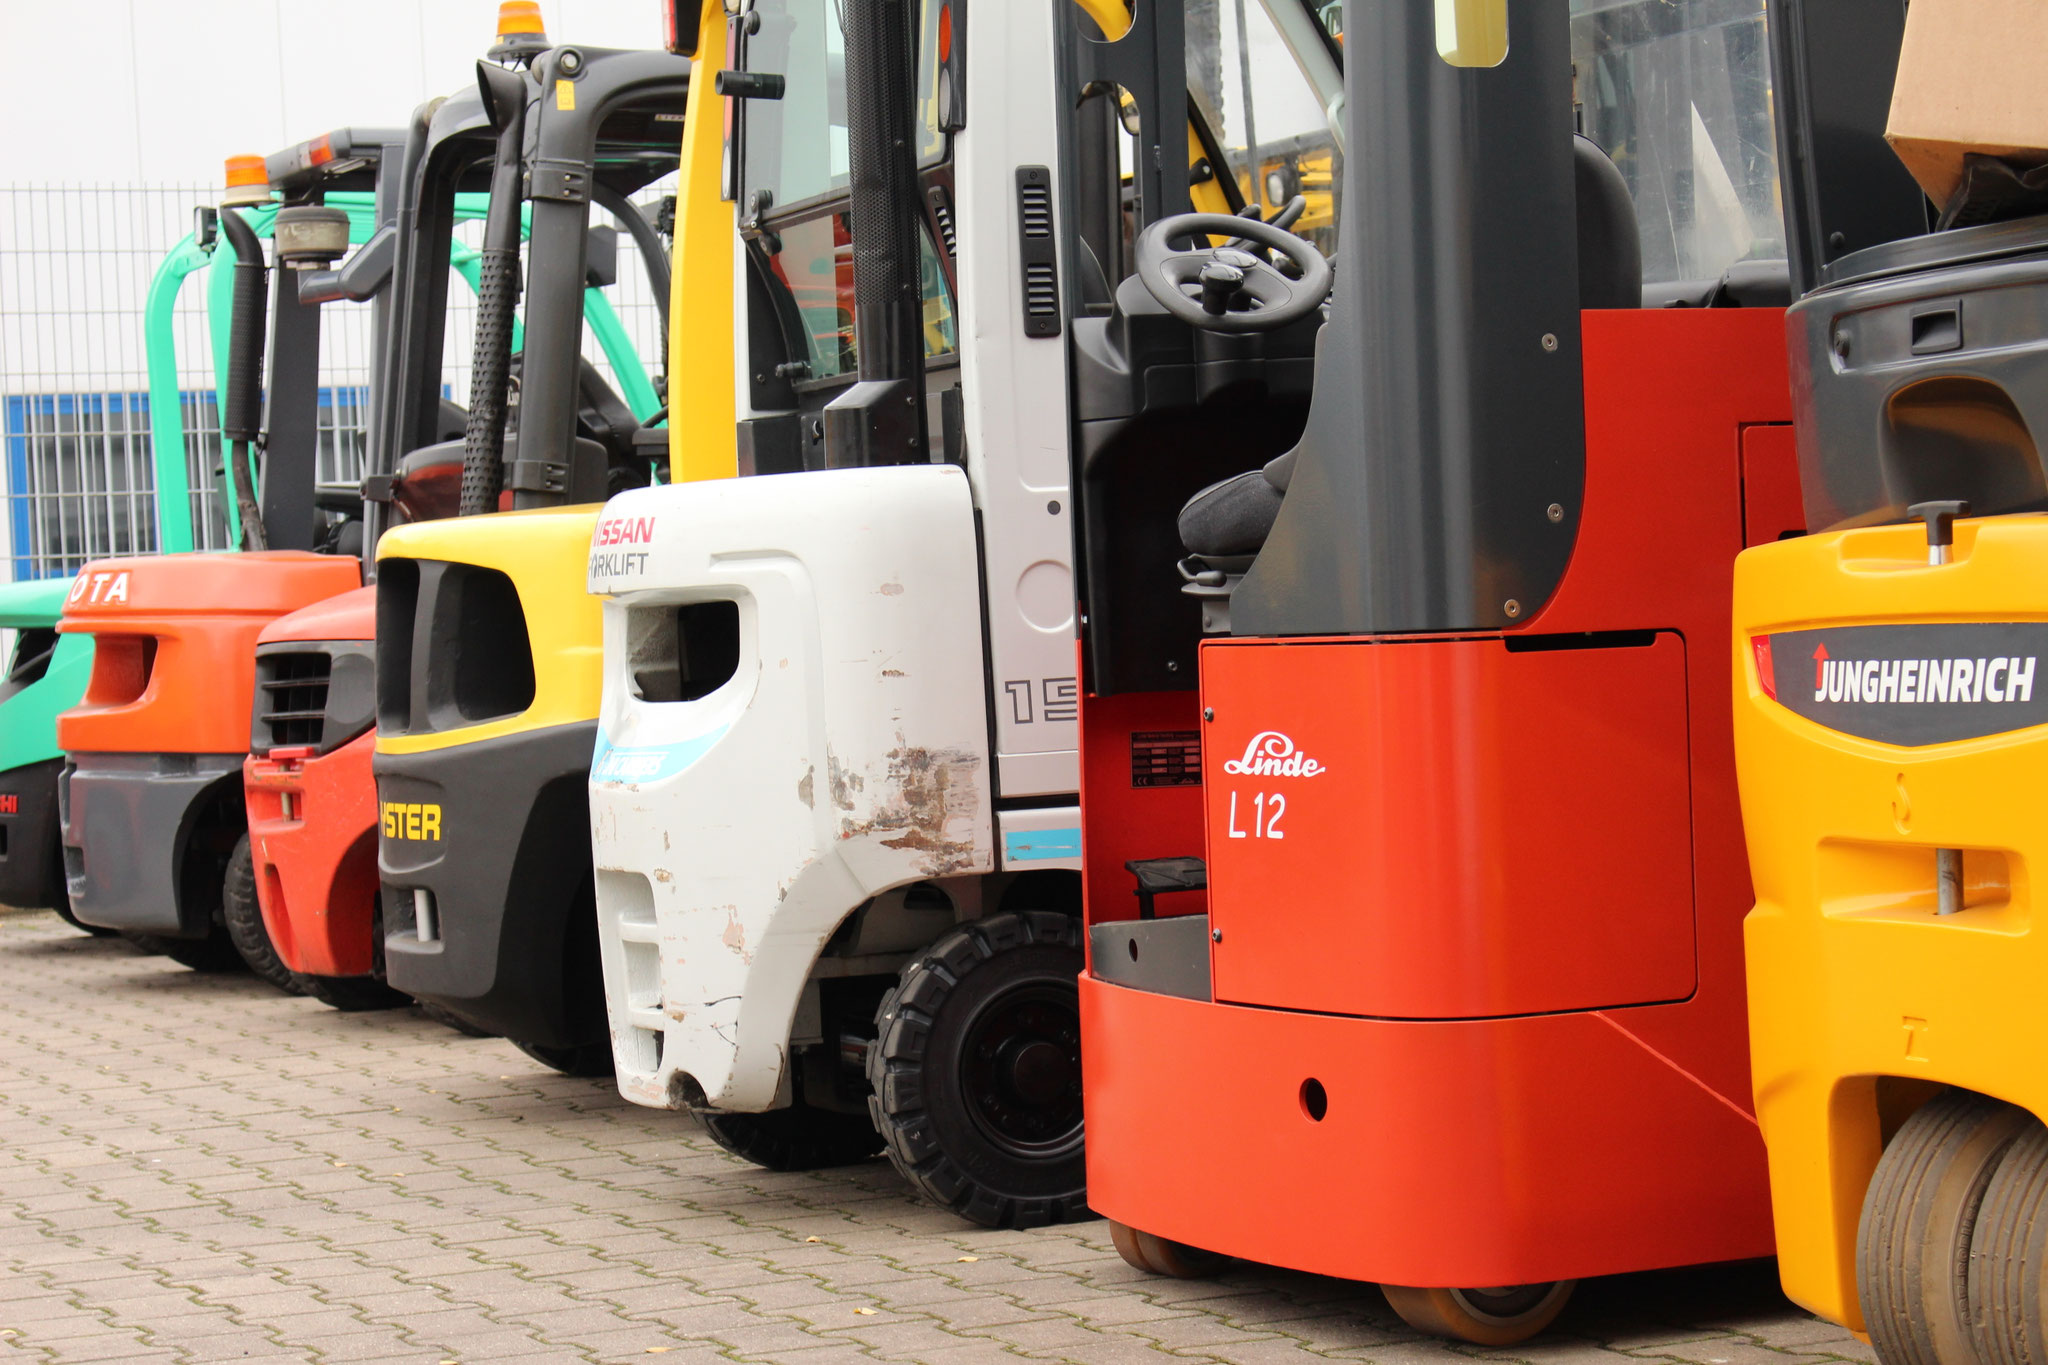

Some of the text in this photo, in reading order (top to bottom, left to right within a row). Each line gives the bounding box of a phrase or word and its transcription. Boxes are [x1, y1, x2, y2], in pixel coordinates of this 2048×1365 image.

[588, 552, 649, 579] ORKLIFT
[70, 571, 131, 603] OTA
[1814, 657, 2037, 703] JUNGHEINRICH
[1223, 731, 1326, 778] Linde
[0, 794, 18, 813] HI
[1228, 790, 1287, 840] L 12
